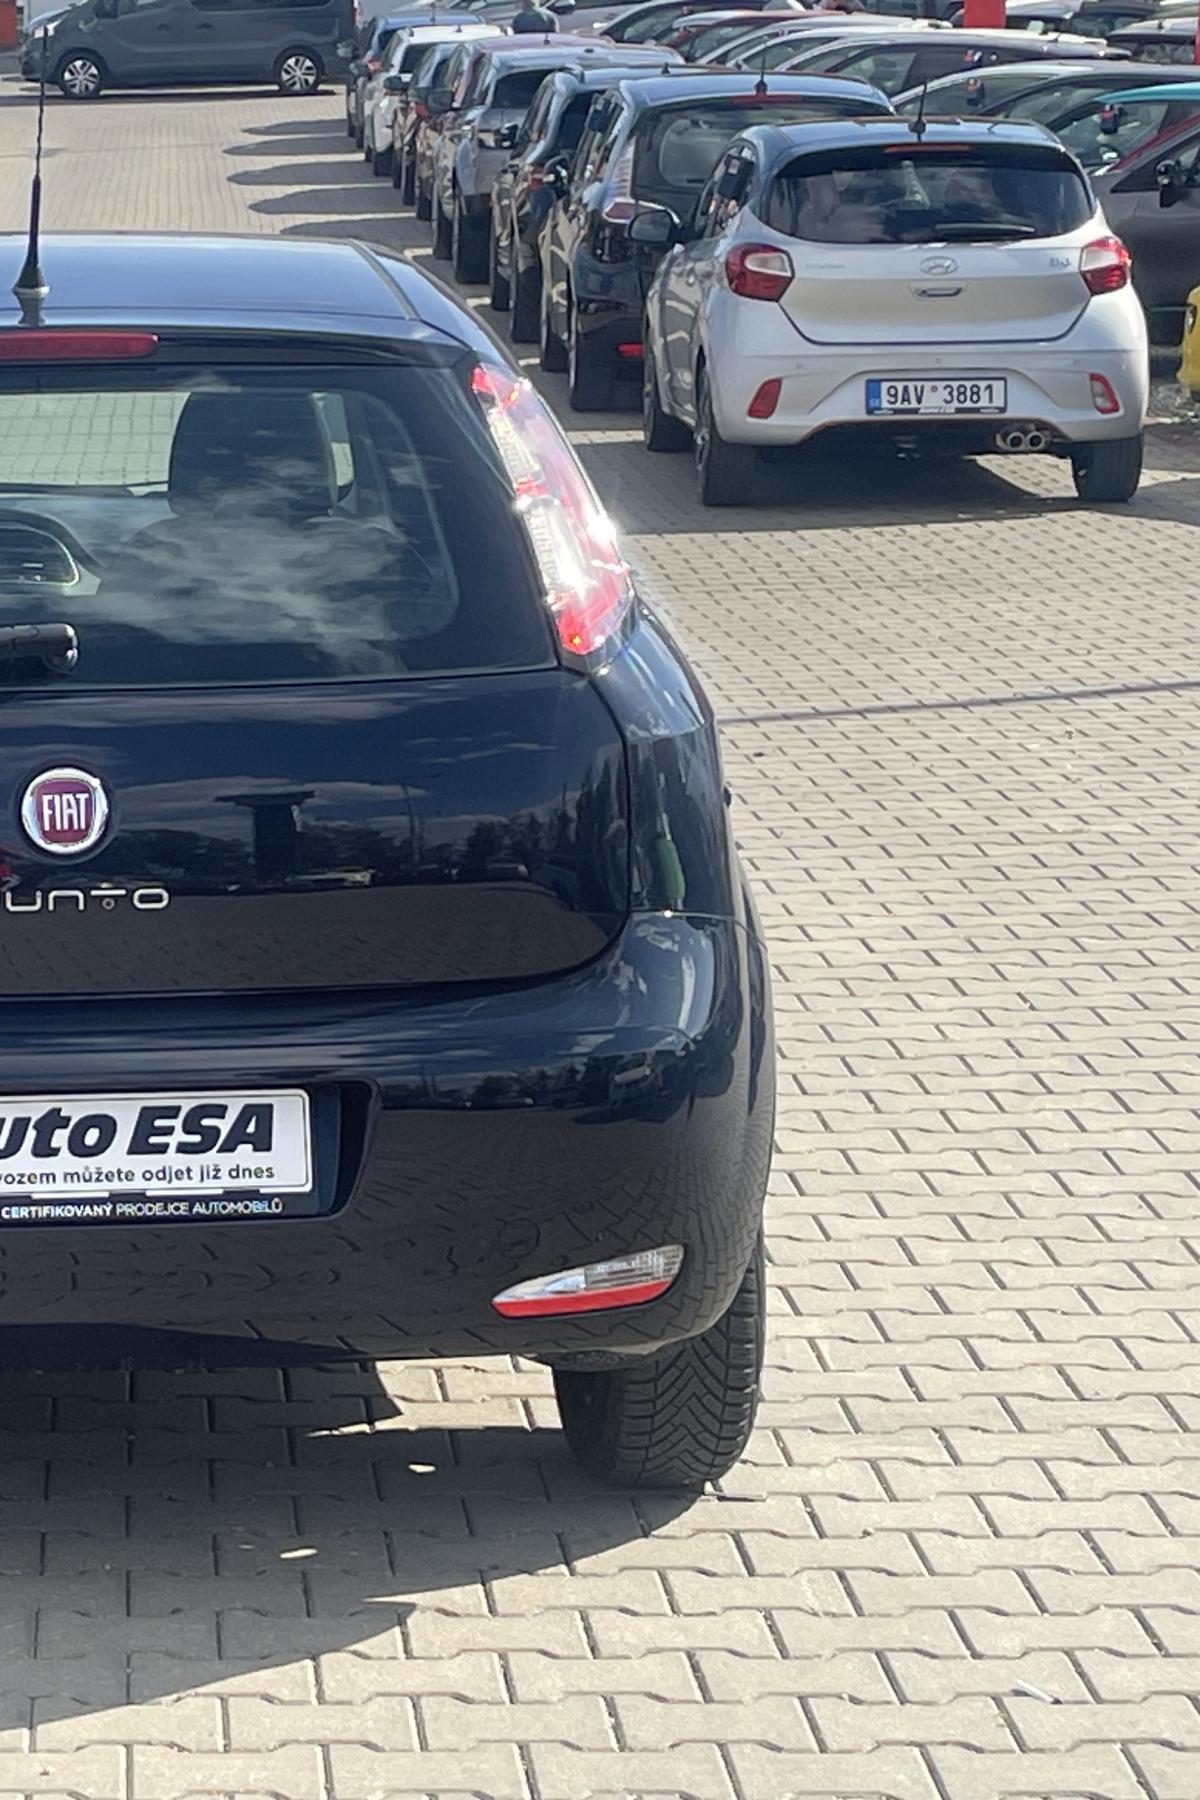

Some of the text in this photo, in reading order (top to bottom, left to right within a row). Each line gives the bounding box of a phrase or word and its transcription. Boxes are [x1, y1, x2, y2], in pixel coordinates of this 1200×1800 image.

[886, 384, 925, 405] 9AV
[943, 383, 994, 404] 3881
[42, 793, 89, 832] FIAT
[126, 1103, 274, 1156] ESA
[62, 1166, 136, 1185] můžete
[141, 1164, 194, 1184] odjet
[199, 1163, 223, 1183] již
[228, 1163, 275, 1180] dnes
[1, 1202, 114, 1220] CERTIFIKOVANÝ
[116, 1202, 190, 1216] PRODEJCE
